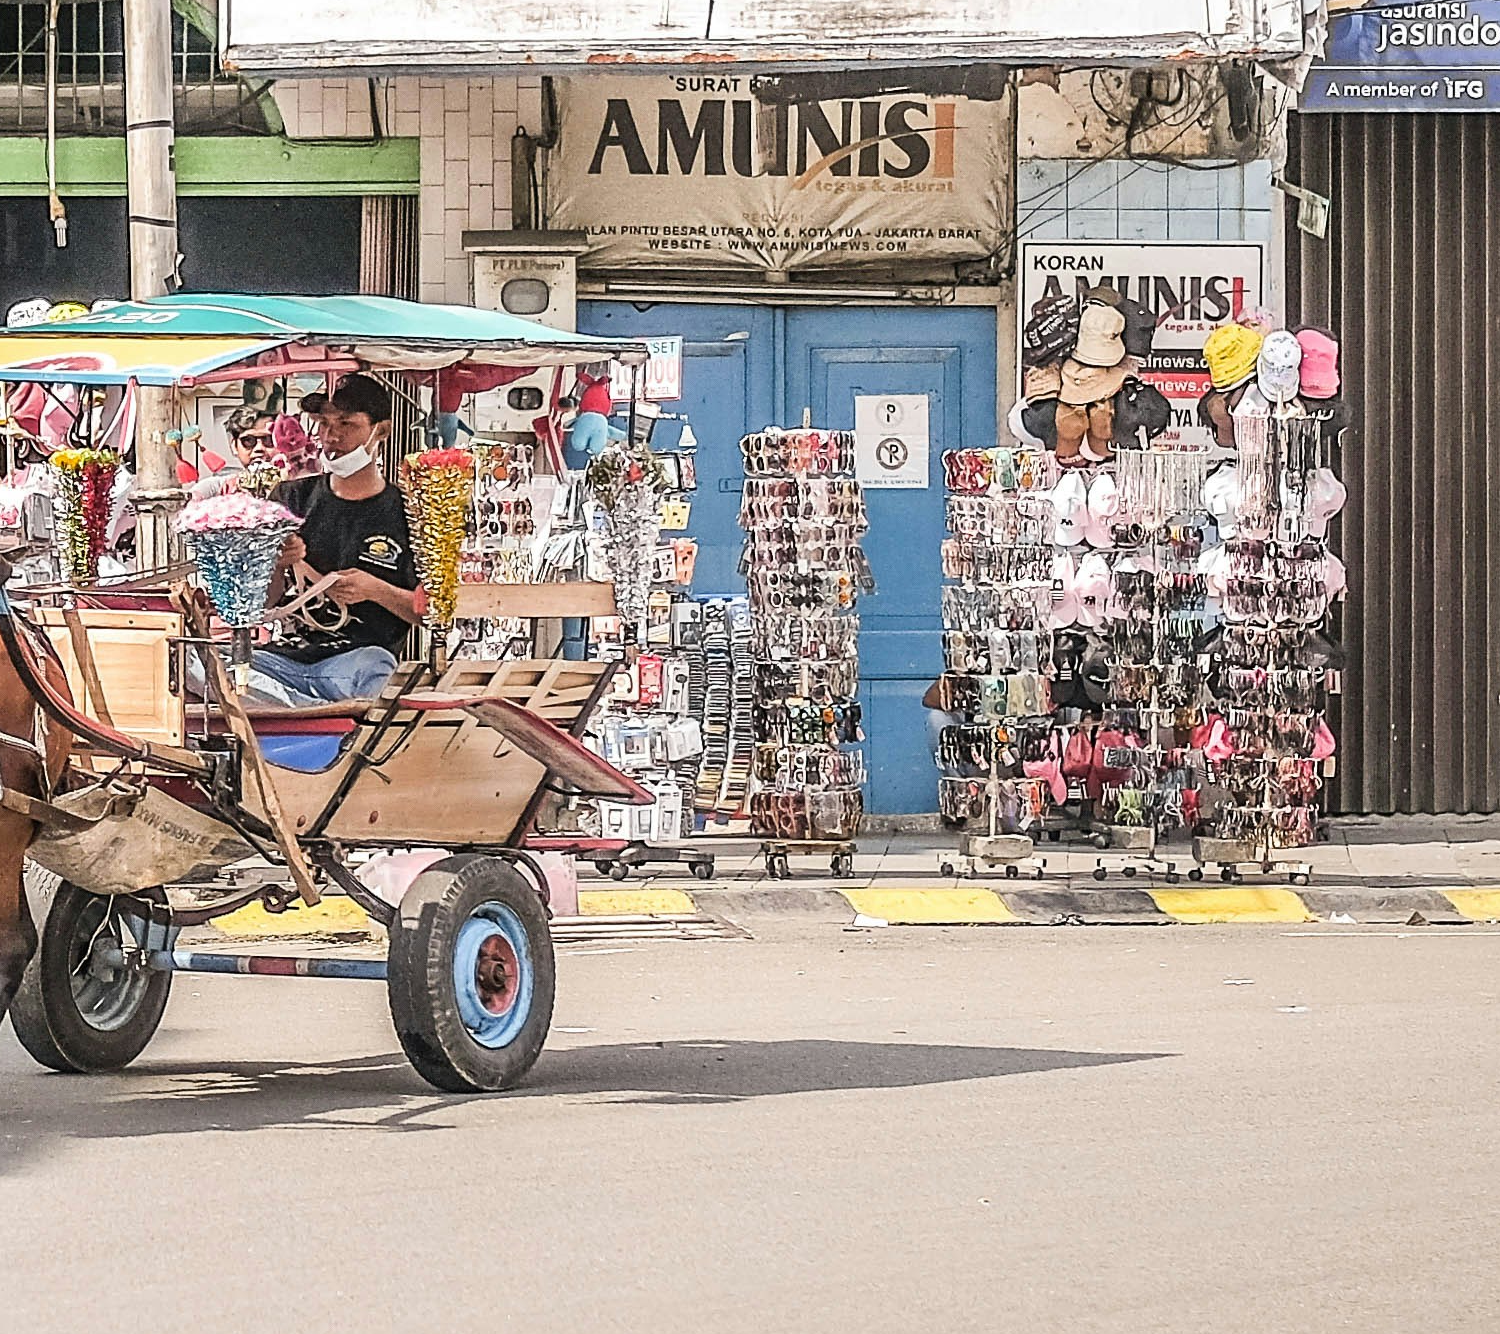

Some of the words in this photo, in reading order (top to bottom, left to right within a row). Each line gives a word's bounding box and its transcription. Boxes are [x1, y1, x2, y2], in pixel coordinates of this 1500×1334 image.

[675, 78, 741, 93] SURAT
[1326, 82, 1340, 97] A
[1343, 81, 1417, 98] member
[1420, 81, 1439, 97] of
[587, 98, 956, 179] AMUNISI
[621, 226, 659, 236] PINTU
[663, 226, 707, 236] BESAR
[711, 227, 754, 237] UTARA
[799, 227, 833, 238] KOTA
[838, 228, 863, 238] TUA
[874, 228, 934, 238] JAKARTA
[938, 228, 982, 239] BARAT
[648, 240, 711, 250] WEBSITE
[1033, 255, 1104, 271] KORAN
